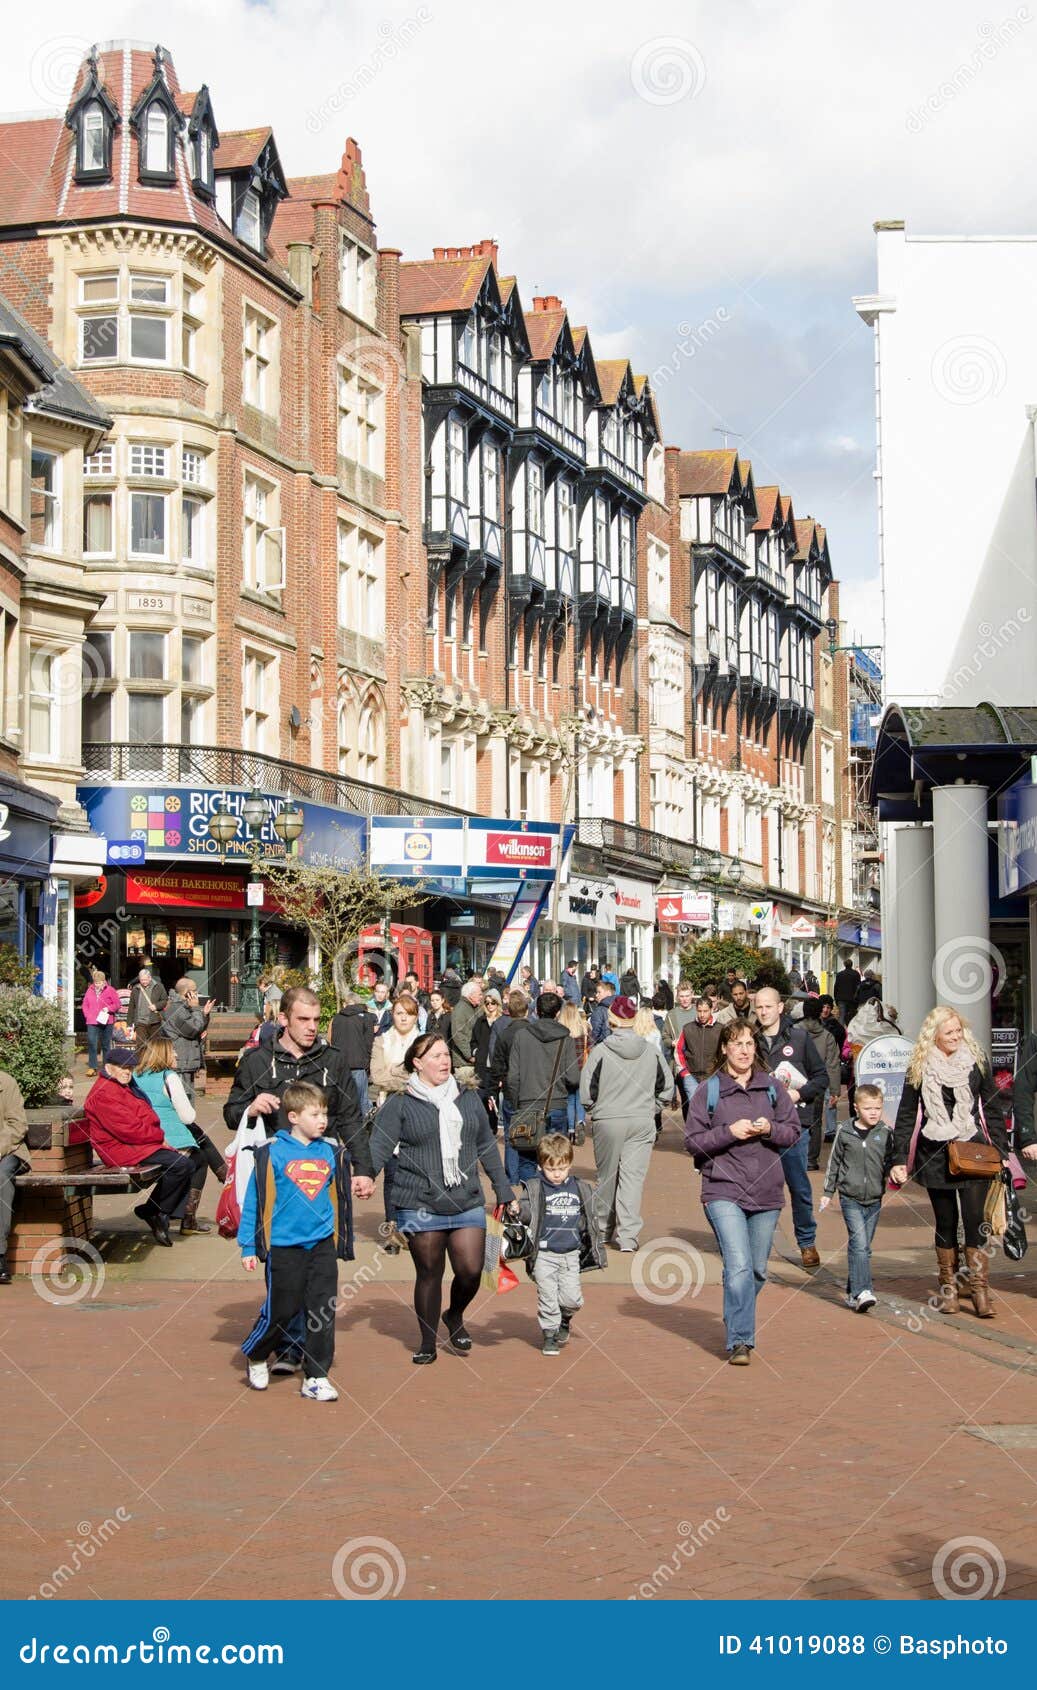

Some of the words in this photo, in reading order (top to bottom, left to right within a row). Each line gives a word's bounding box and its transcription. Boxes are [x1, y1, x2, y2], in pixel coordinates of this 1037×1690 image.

[138, 598, 163, 608] 1893
[190, 793, 285, 818] RICHND
[109, 845, 141, 859] SB
[498, 839, 545, 857] wilkinson
[133, 875, 178, 888] CORNISH
[182, 879, 239, 891] BAKEHOUSE
[870, 1048, 913, 1058] Doldson
